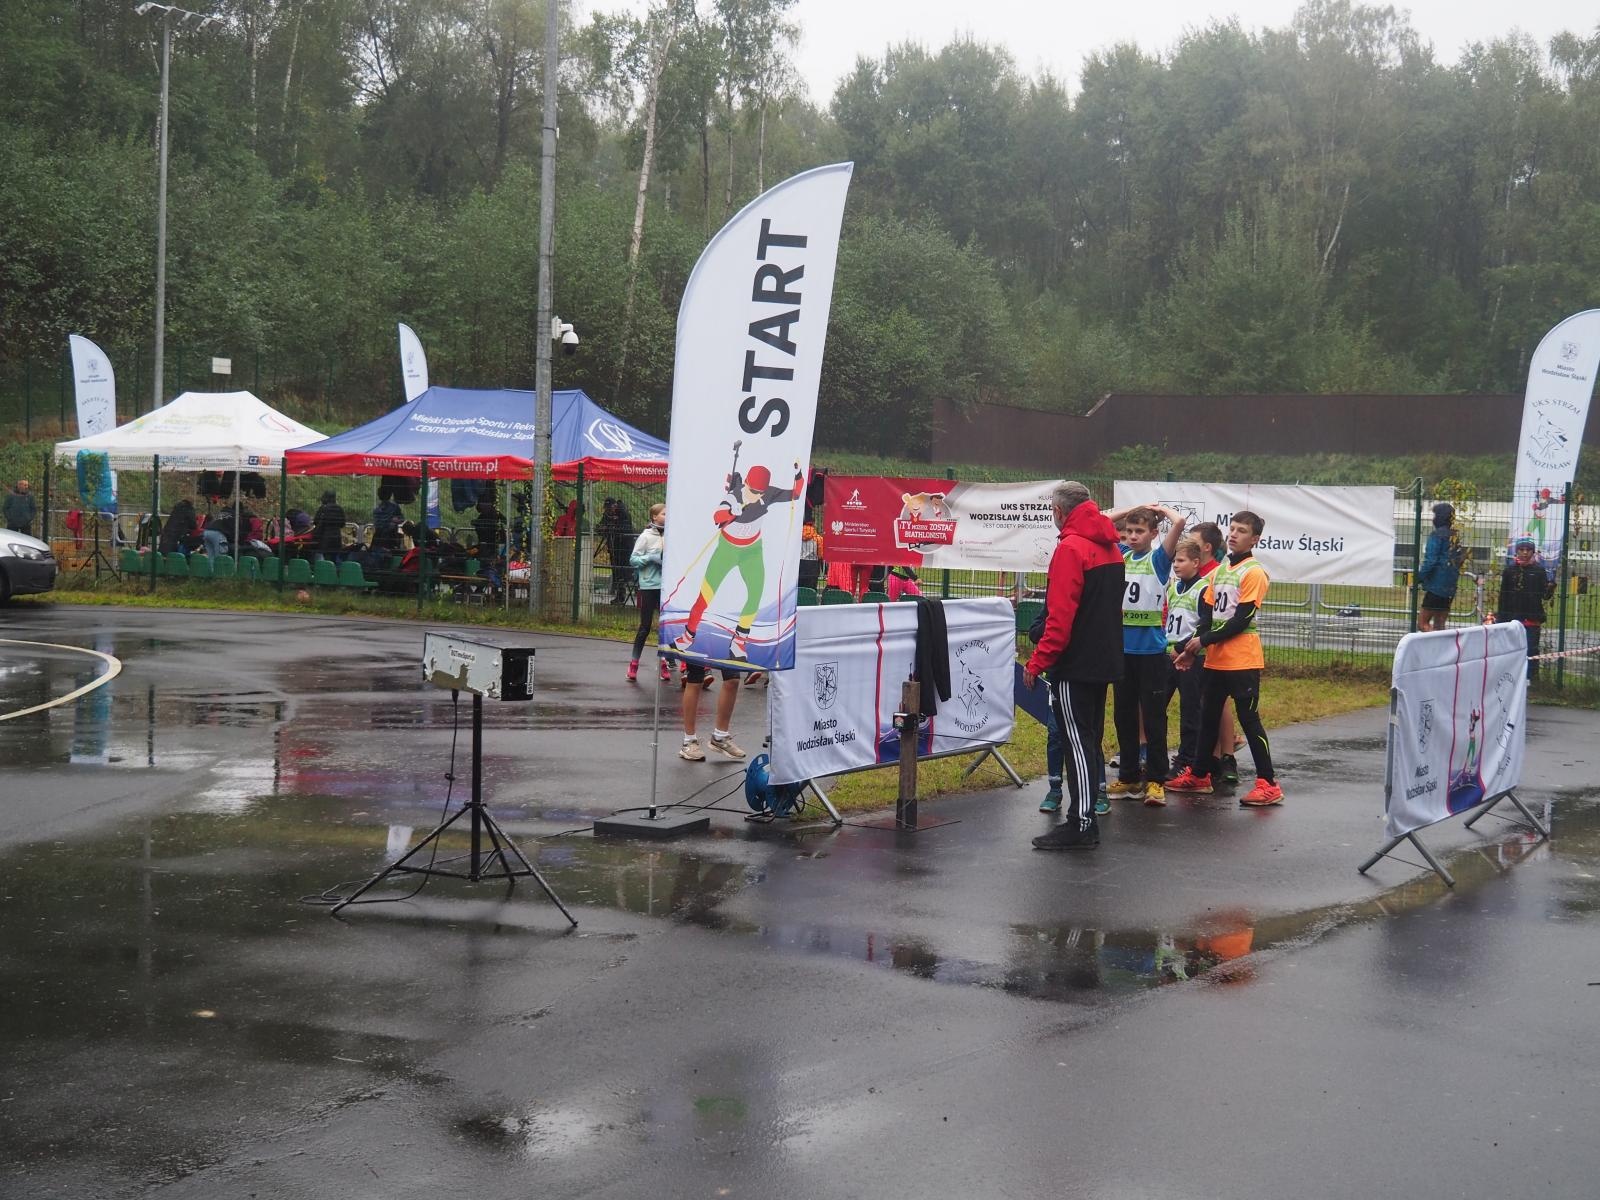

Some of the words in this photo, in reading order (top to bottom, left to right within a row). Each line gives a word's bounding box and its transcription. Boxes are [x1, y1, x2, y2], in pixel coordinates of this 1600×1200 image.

[738, 218, 808, 438] START
[1531, 398, 1550, 408] UKS
[410, 413, 442, 424] Miejski
[442, 417, 477, 426] Ośrodek
[476, 416, 509, 429] Sportu
[463, 426, 512, 439] Wodzisław
[363, 456, 498, 475] www.mosi-centrum.pl
[1000, 503, 1018, 511] UKS
[901, 521, 912, 530] TY
[929, 522, 953, 531] ZOSTAĆ
[969, 513, 1021, 522] WODZISŁAW
[1023, 512, 1052, 524] ŚLĄSKI
[905, 530, 947, 541] BIATHLONISTĄ
[1298, 533, 1344, 556] Śląski
[1213, 591, 1228, 613] 80
[1167, 613, 1183, 635] 81
[955, 641, 969, 658] UKS
[969, 639, 991, 655] STRZAŁ
[813, 718, 837, 731] Miasto
[953, 711, 991, 733] WODZISŁAW
[796, 734, 834, 753] Wodzisław
[834, 728, 856, 747] Śląski
